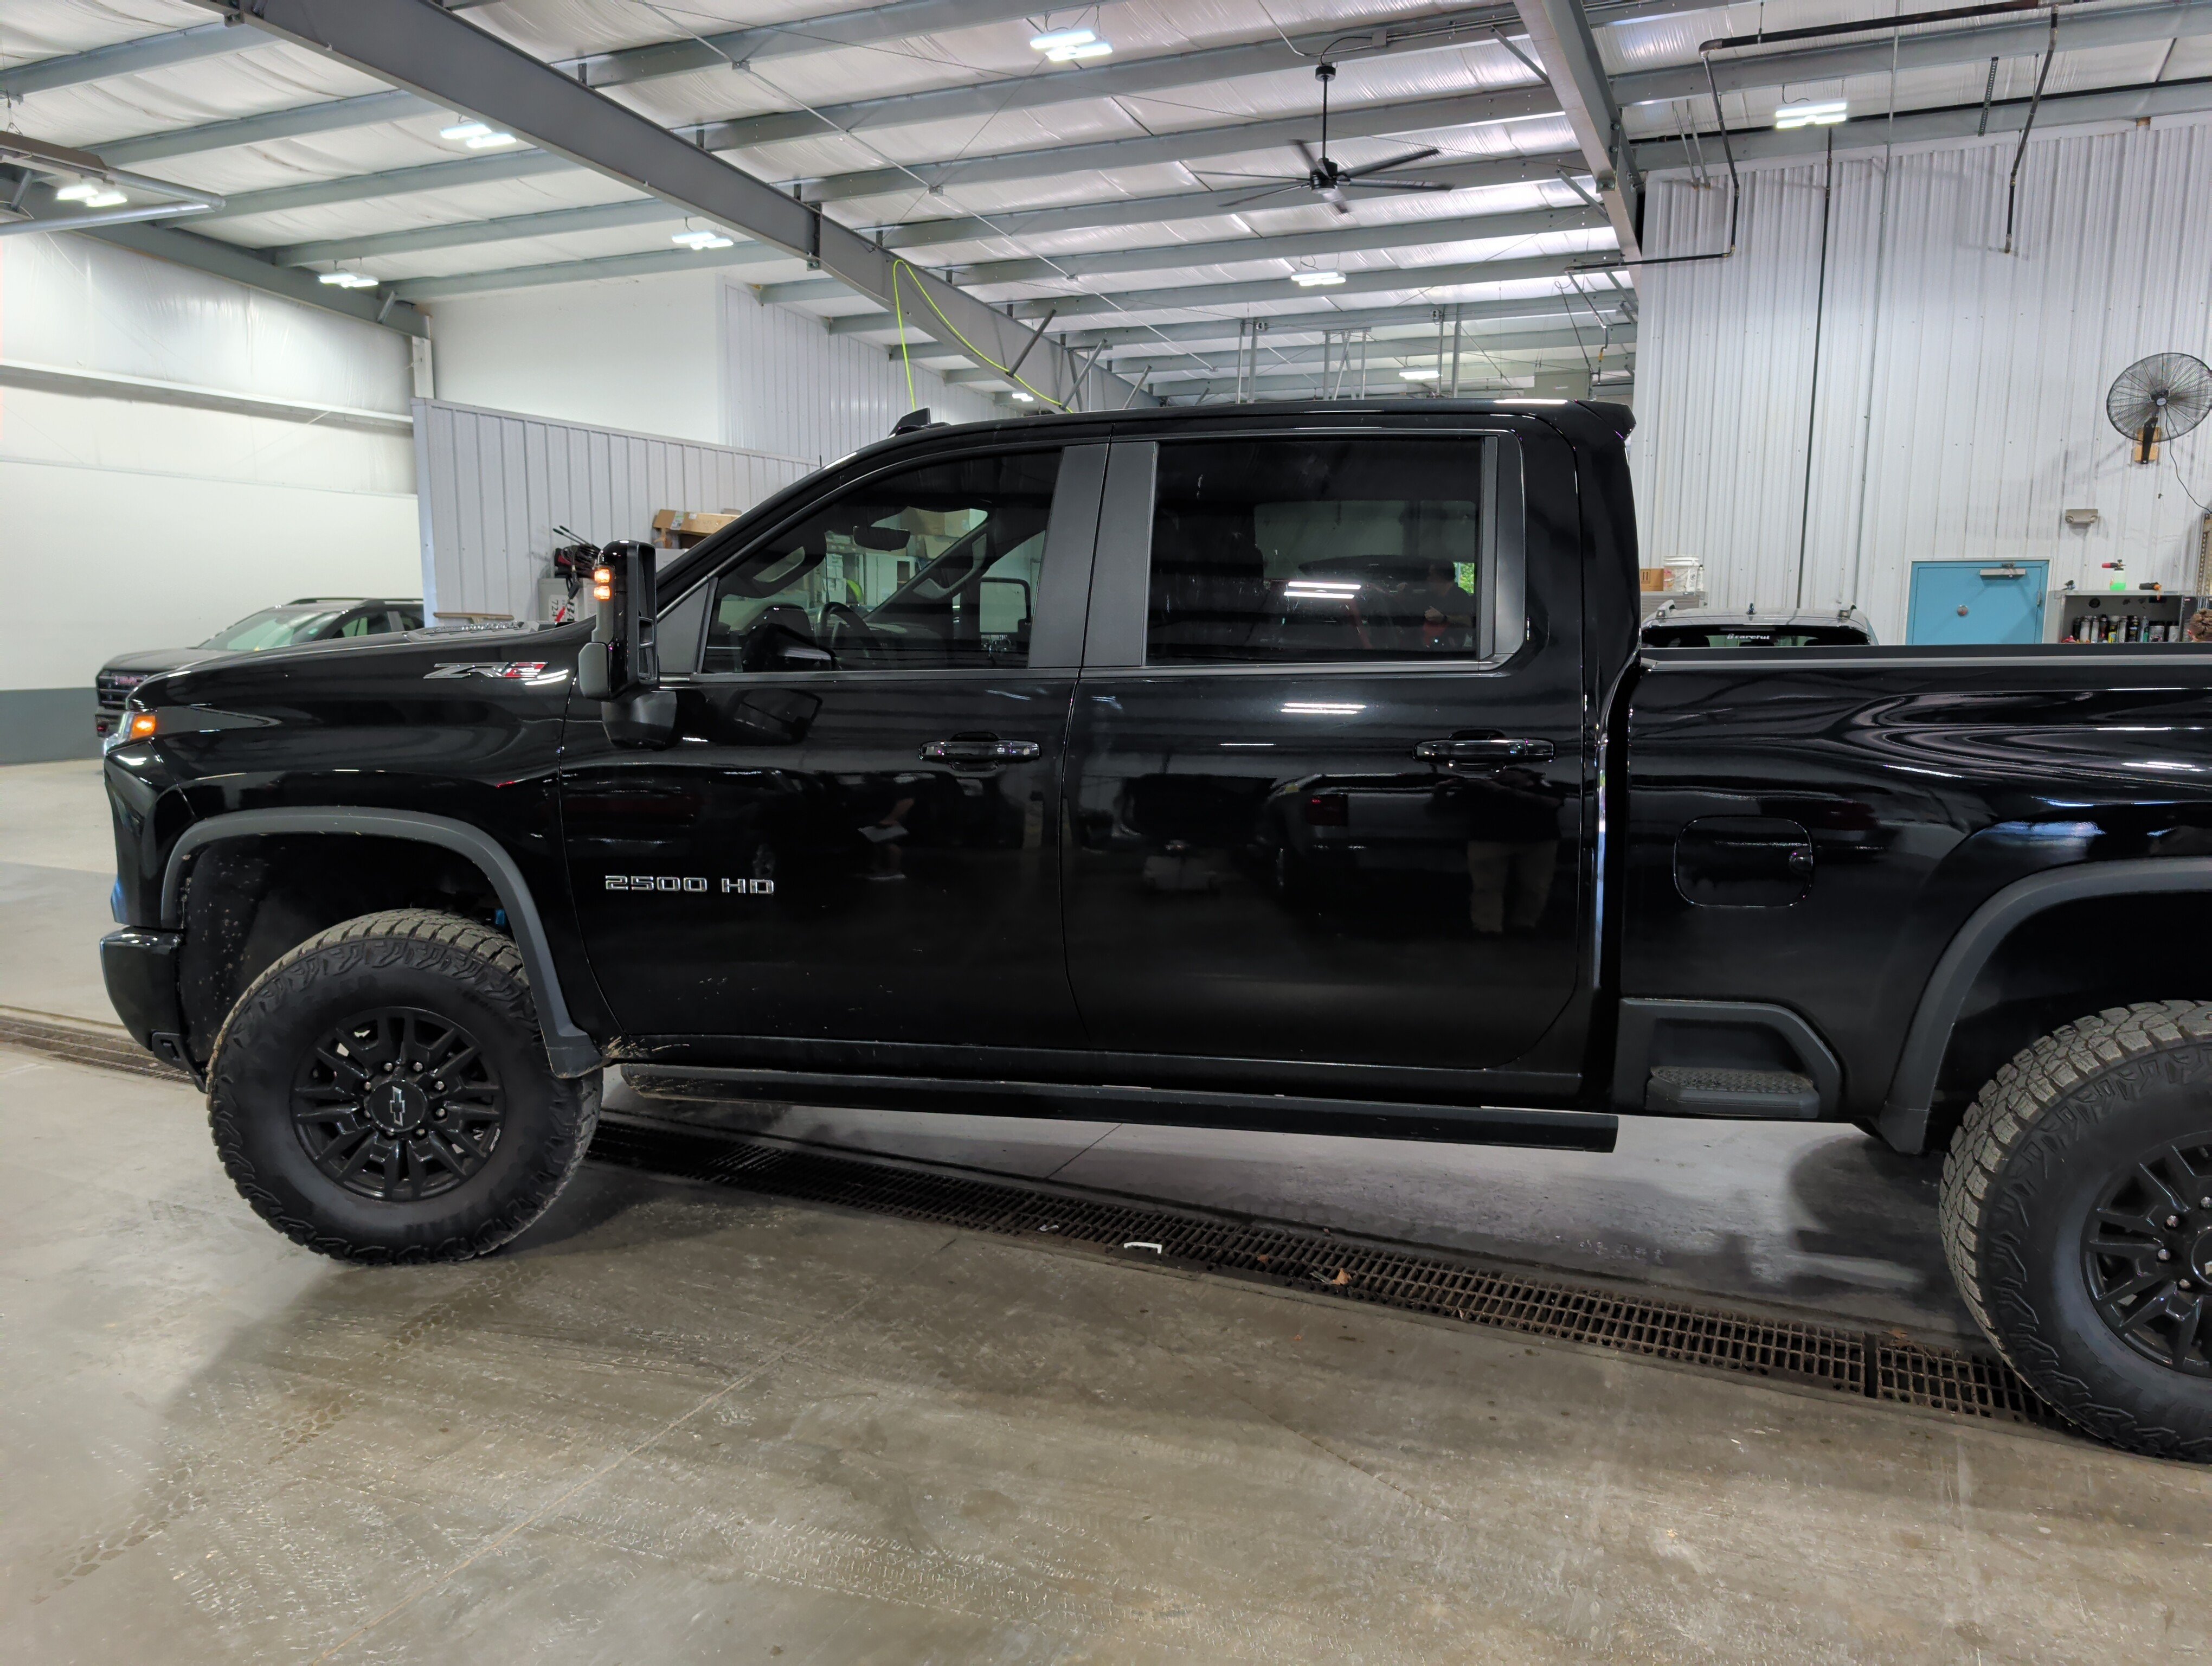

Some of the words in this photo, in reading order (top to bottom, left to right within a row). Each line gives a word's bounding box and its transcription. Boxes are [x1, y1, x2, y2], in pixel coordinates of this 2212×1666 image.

[423, 662, 549, 680] ZR2
[605, 875, 708, 892] 2500
[721, 877, 774, 894] HD
